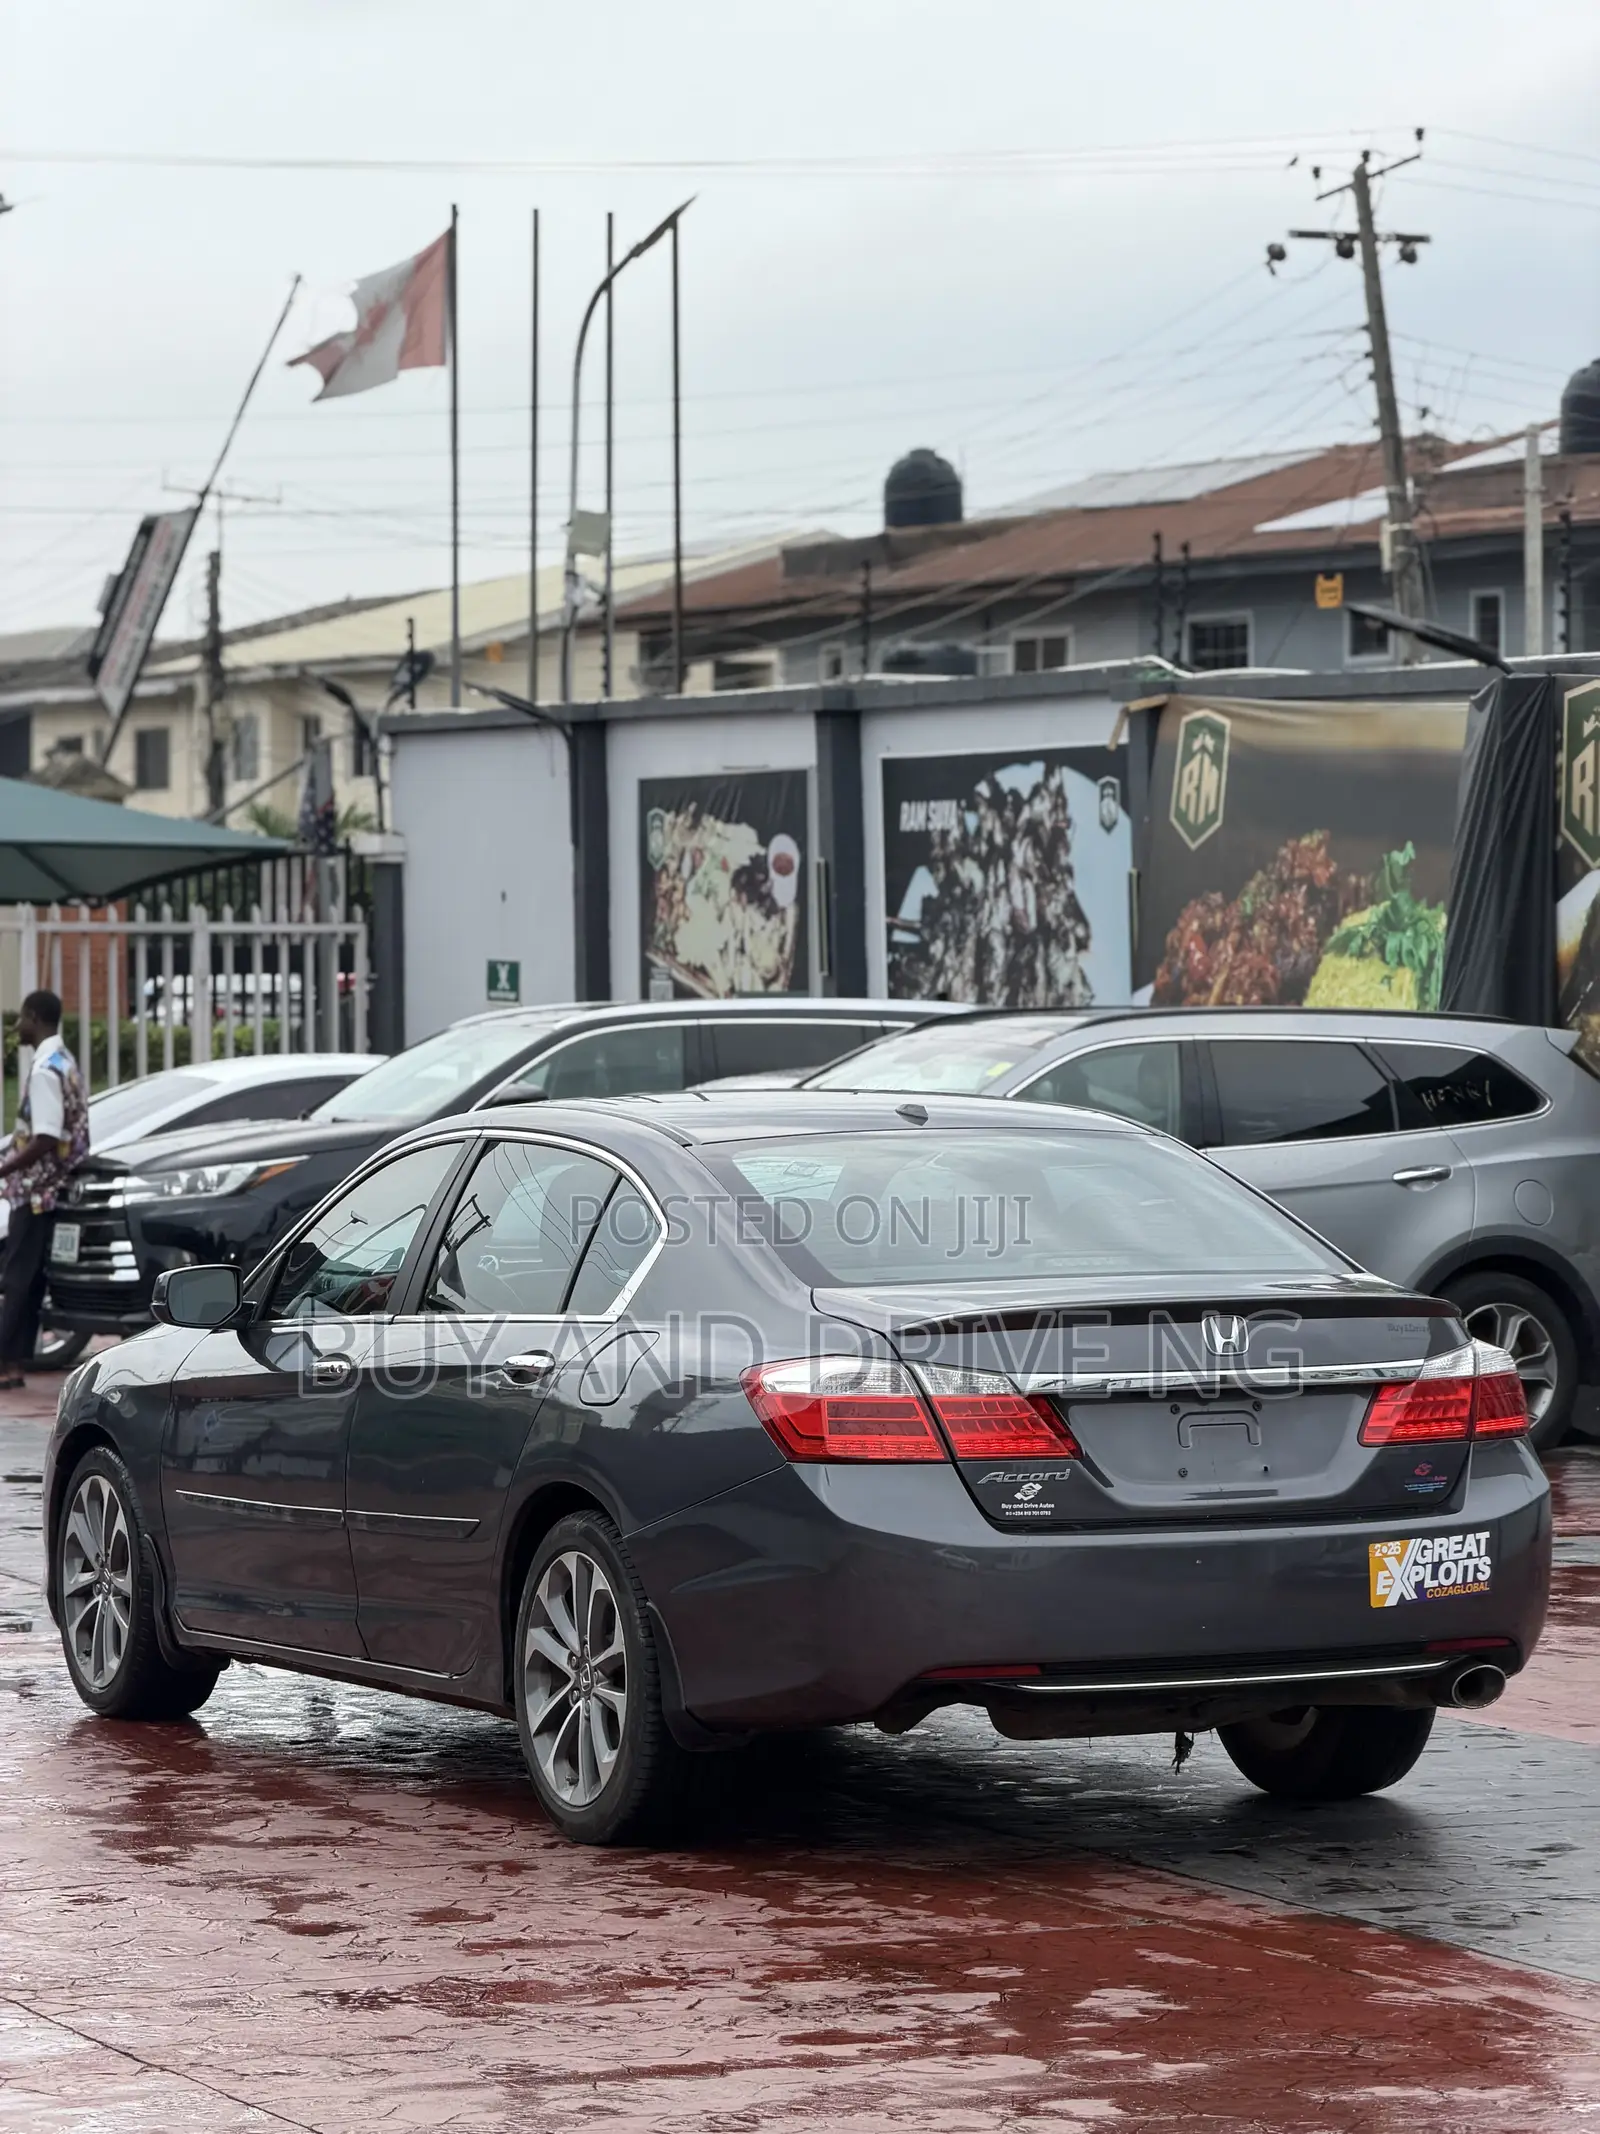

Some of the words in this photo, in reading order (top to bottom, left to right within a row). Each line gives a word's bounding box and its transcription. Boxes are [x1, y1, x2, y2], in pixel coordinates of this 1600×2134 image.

[977, 1468, 1071, 1485] Accord
[1415, 1531, 1491, 1565] GREAT
[1376, 1555, 1492, 1607] EXPLOITS
[1426, 1581, 1490, 1599] COZAGLOBAL
